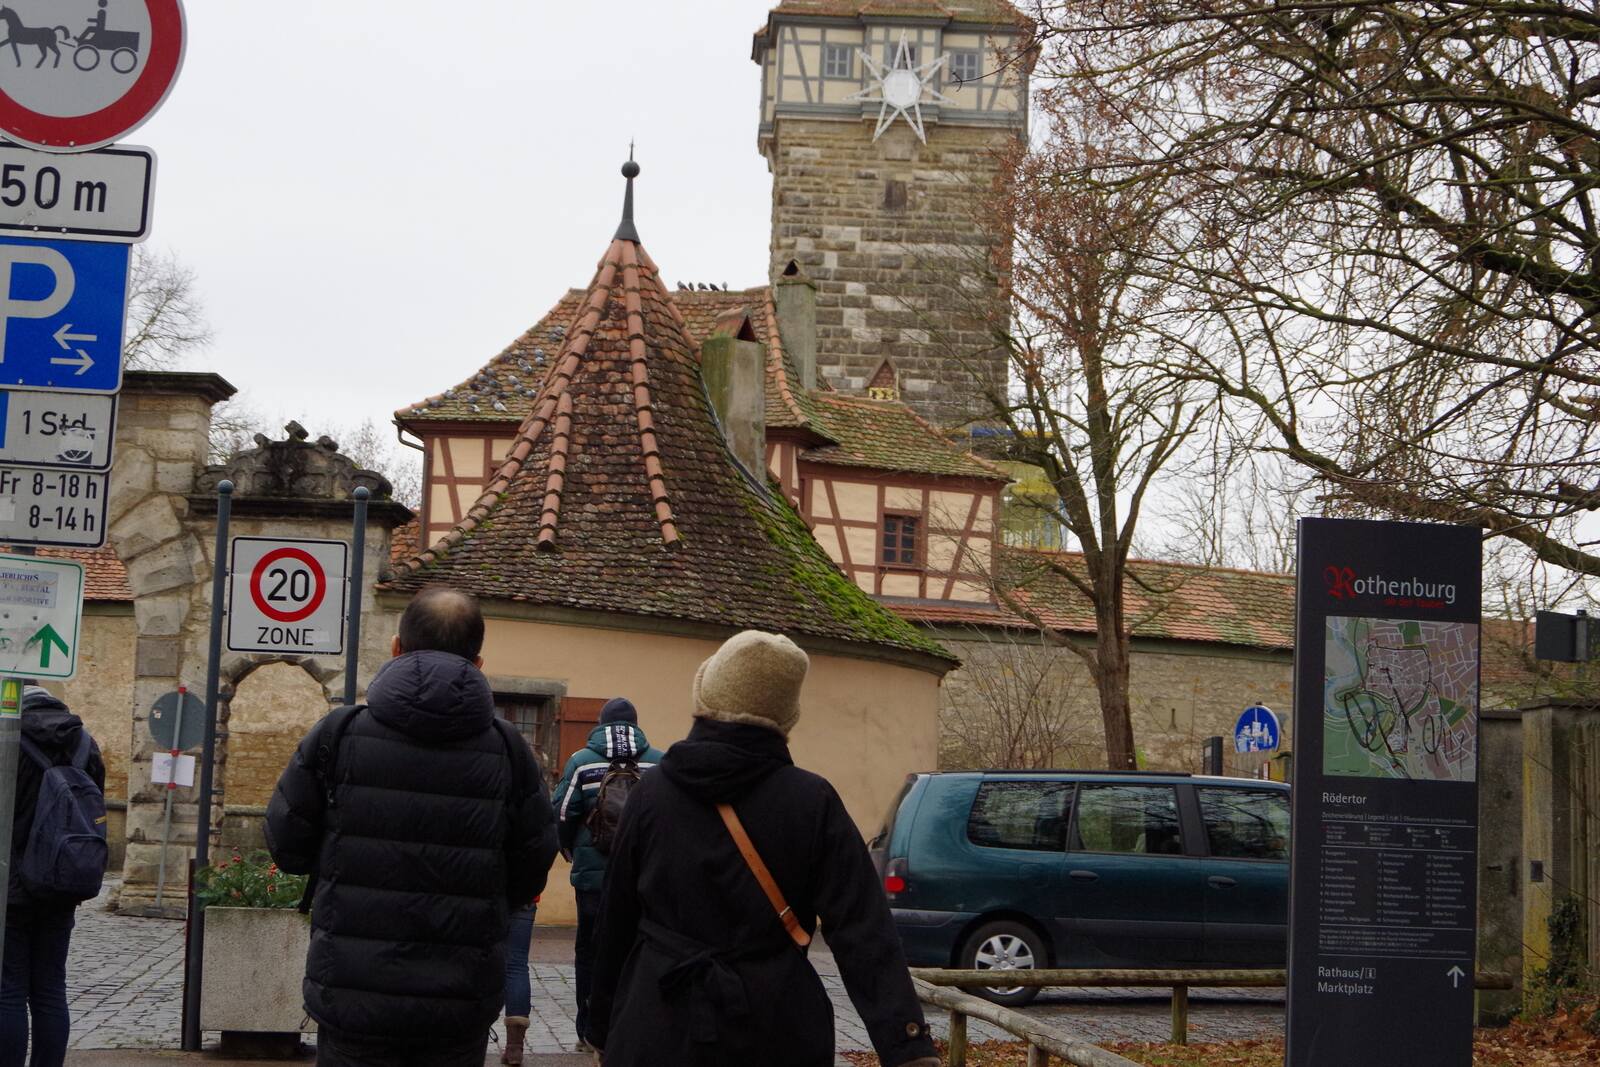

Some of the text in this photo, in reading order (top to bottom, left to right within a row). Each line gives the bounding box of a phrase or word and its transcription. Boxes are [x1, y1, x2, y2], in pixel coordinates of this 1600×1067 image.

[1, 163, 107, 212] 50 m
[22, 409, 32, 435] 1
[0, 471, 21, 495] Fr
[86, 475, 97, 499] h
[29, 504, 95, 532] 8-14 h
[267, 568, 310, 602] 20
[1323, 565, 1456, 604] Rothenburg
[257, 626, 315, 646] ZONE
[1322, 791, 1368, 805] Rödertor
[1317, 981, 1374, 996] Marktplatz
